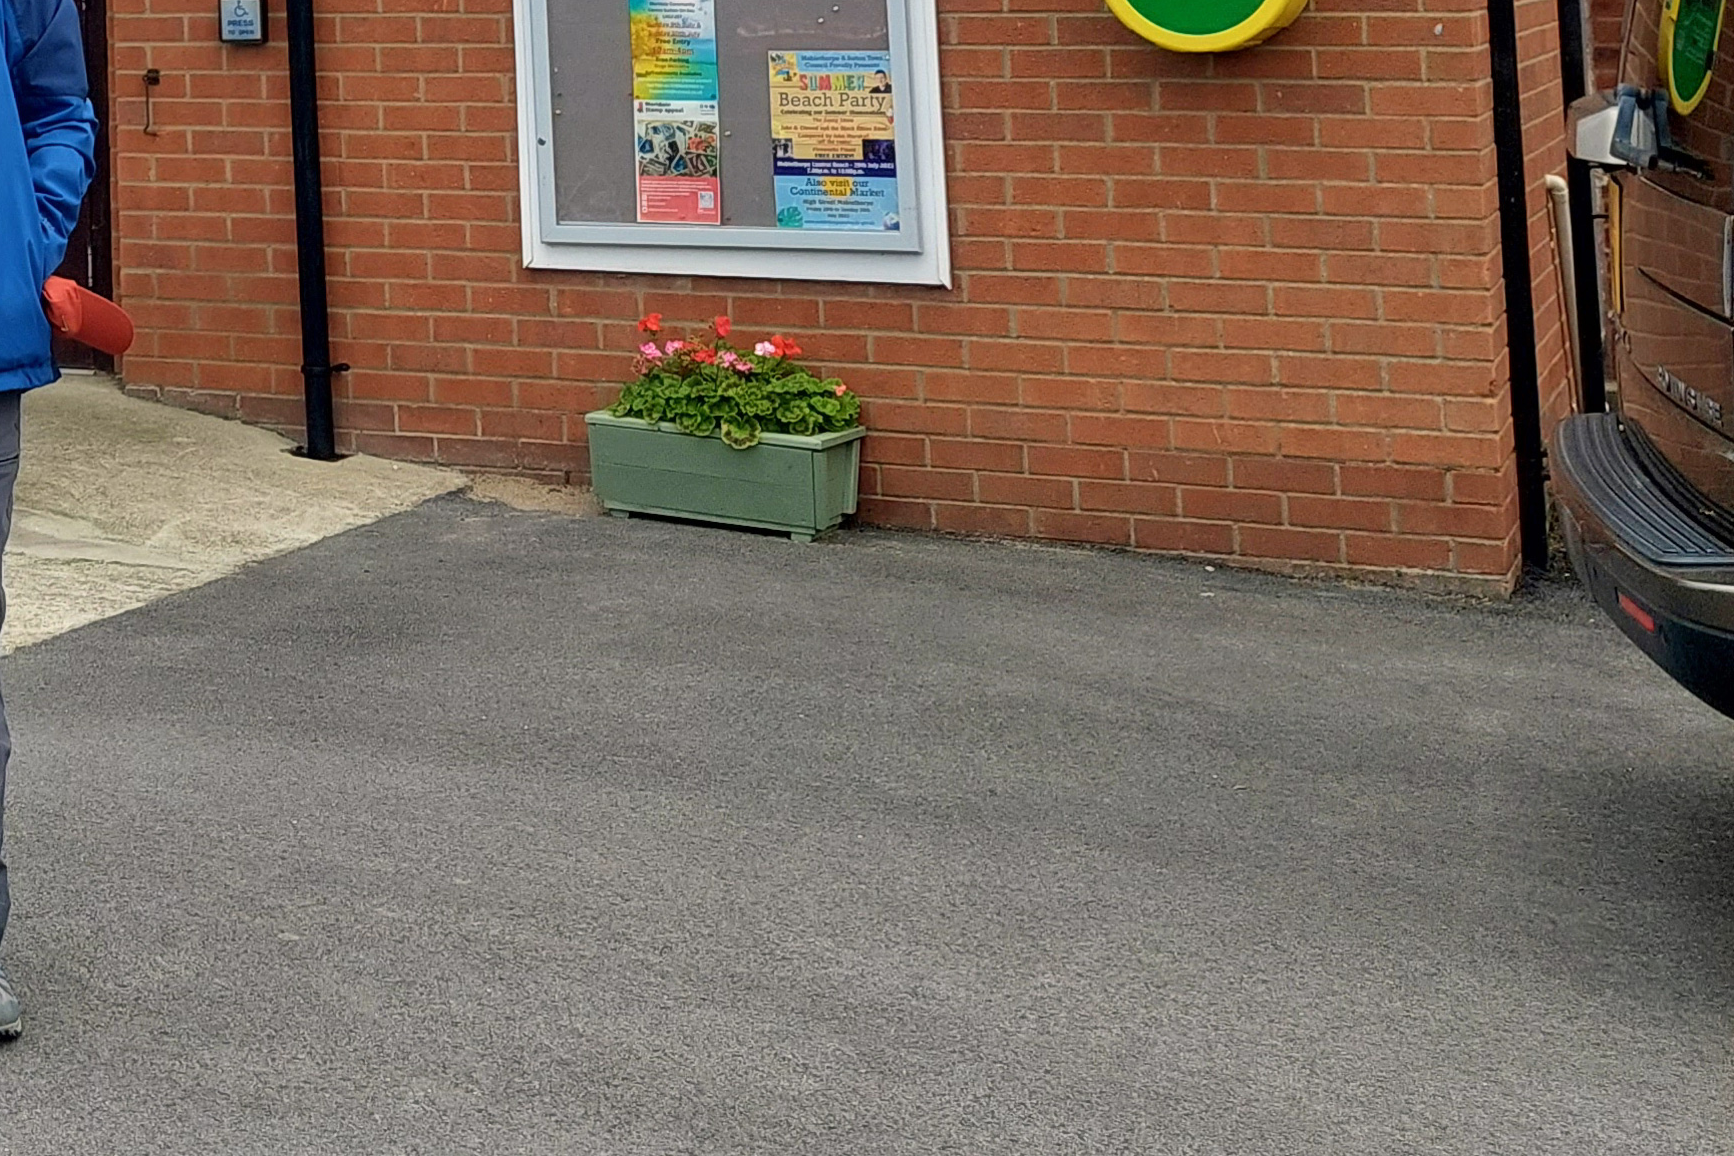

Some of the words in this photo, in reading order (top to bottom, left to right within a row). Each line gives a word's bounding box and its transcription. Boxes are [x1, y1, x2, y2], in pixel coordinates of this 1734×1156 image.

[227, 19, 254, 27] PRESS
[673, 38, 691, 46] Entry
[799, 73, 865, 91] SUMMER
[778, 92, 833, 107] Beach
[839, 92, 886, 112] Party
[805, 177, 826, 187] Also
[829, 178, 850, 187] visit
[790, 186, 847, 197] Continental
[850, 188, 885, 197] Market
